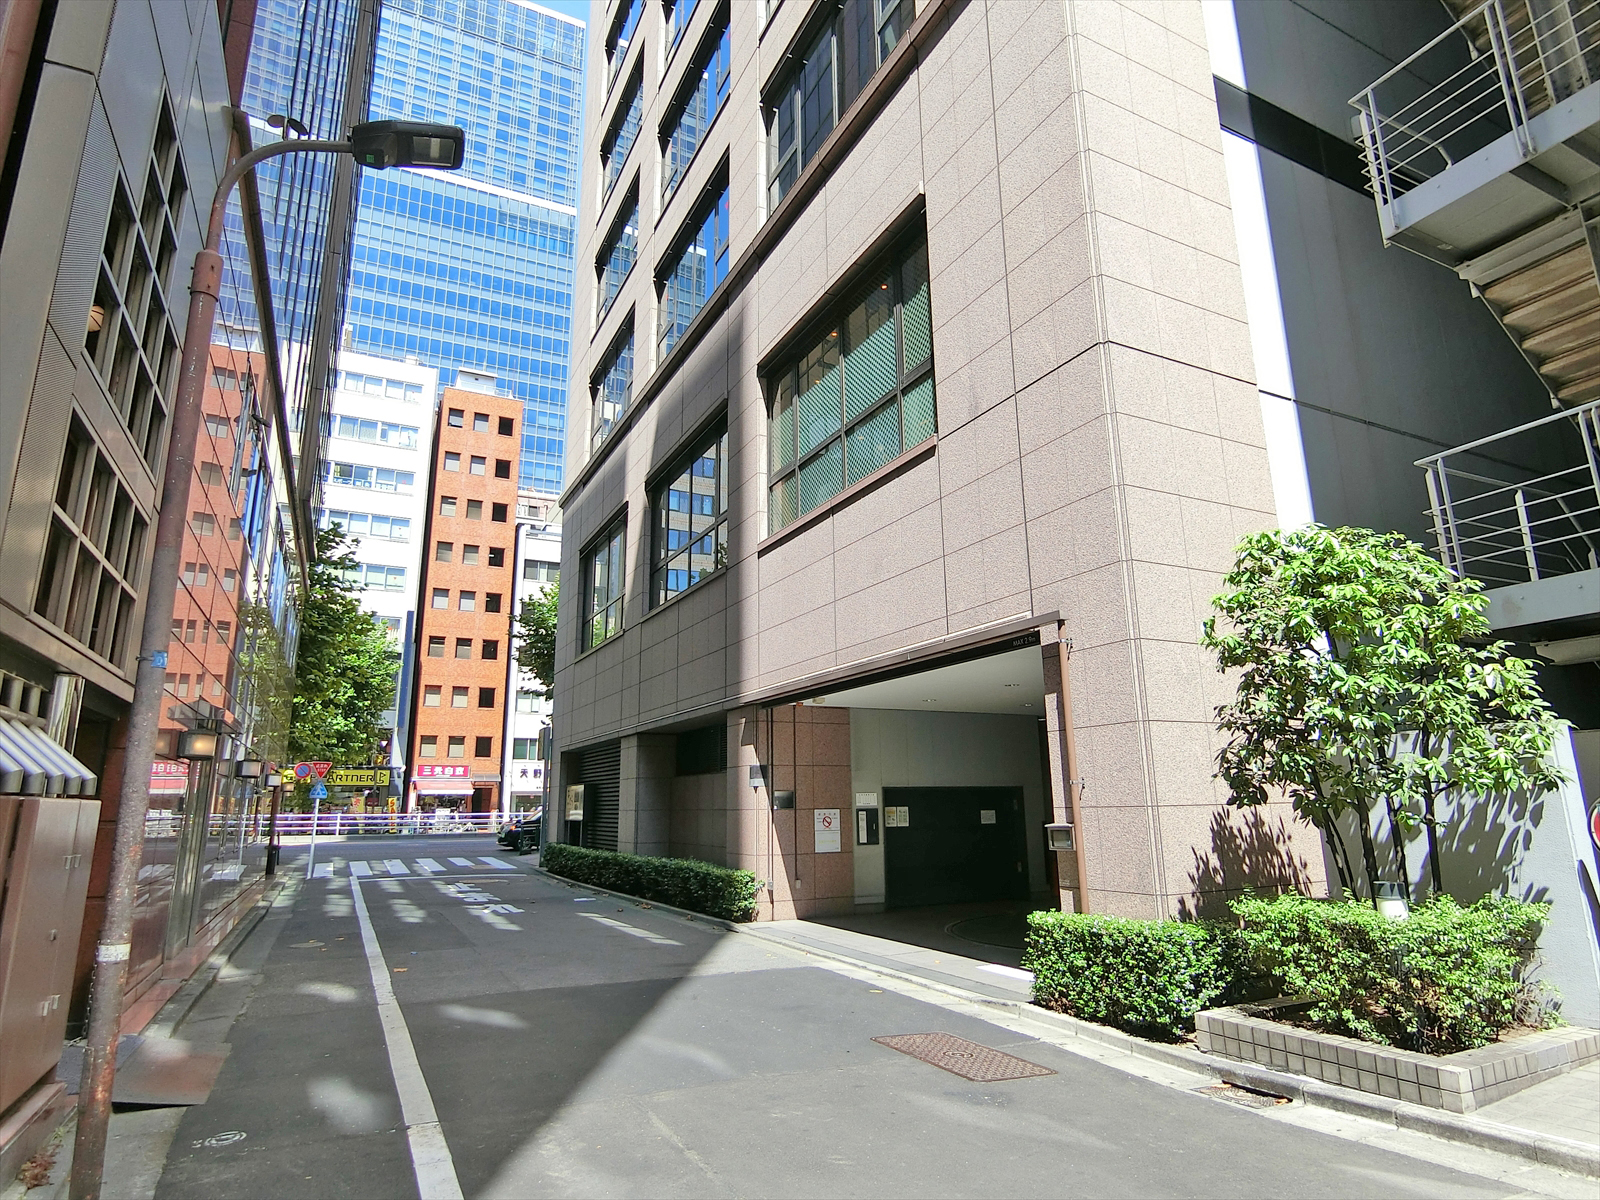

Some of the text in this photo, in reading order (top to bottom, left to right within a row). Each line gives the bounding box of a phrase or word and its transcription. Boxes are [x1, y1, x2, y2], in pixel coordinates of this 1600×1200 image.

[1013, 638, 1024, 646] MAX
[322, 773, 375, 783] ARTNER
[448, 883, 525, 914] 止まれ
